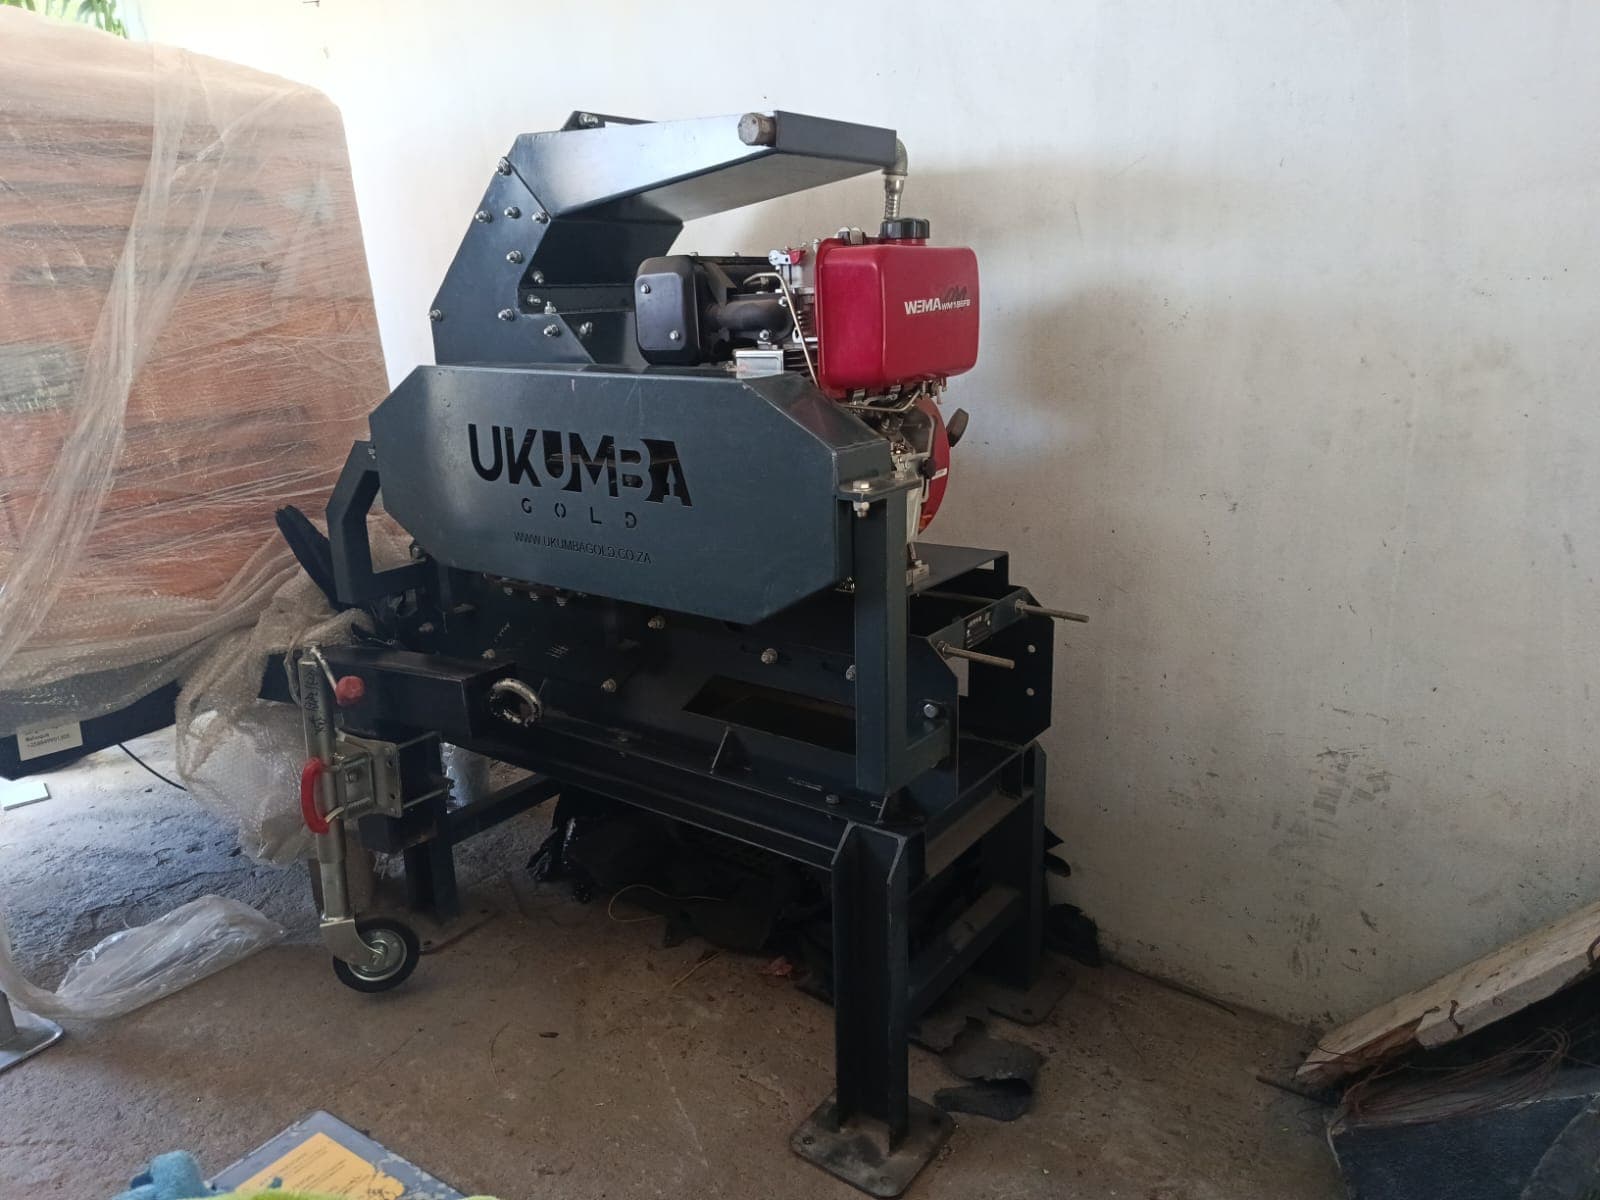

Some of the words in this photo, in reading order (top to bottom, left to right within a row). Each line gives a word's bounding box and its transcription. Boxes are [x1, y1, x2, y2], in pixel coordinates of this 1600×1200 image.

[468, 423, 693, 507] UKUMBA
[520, 497, 637, 529] GOLD
[513, 531, 652, 564] WWW.UKUMBAGOLD.CO.ZA
